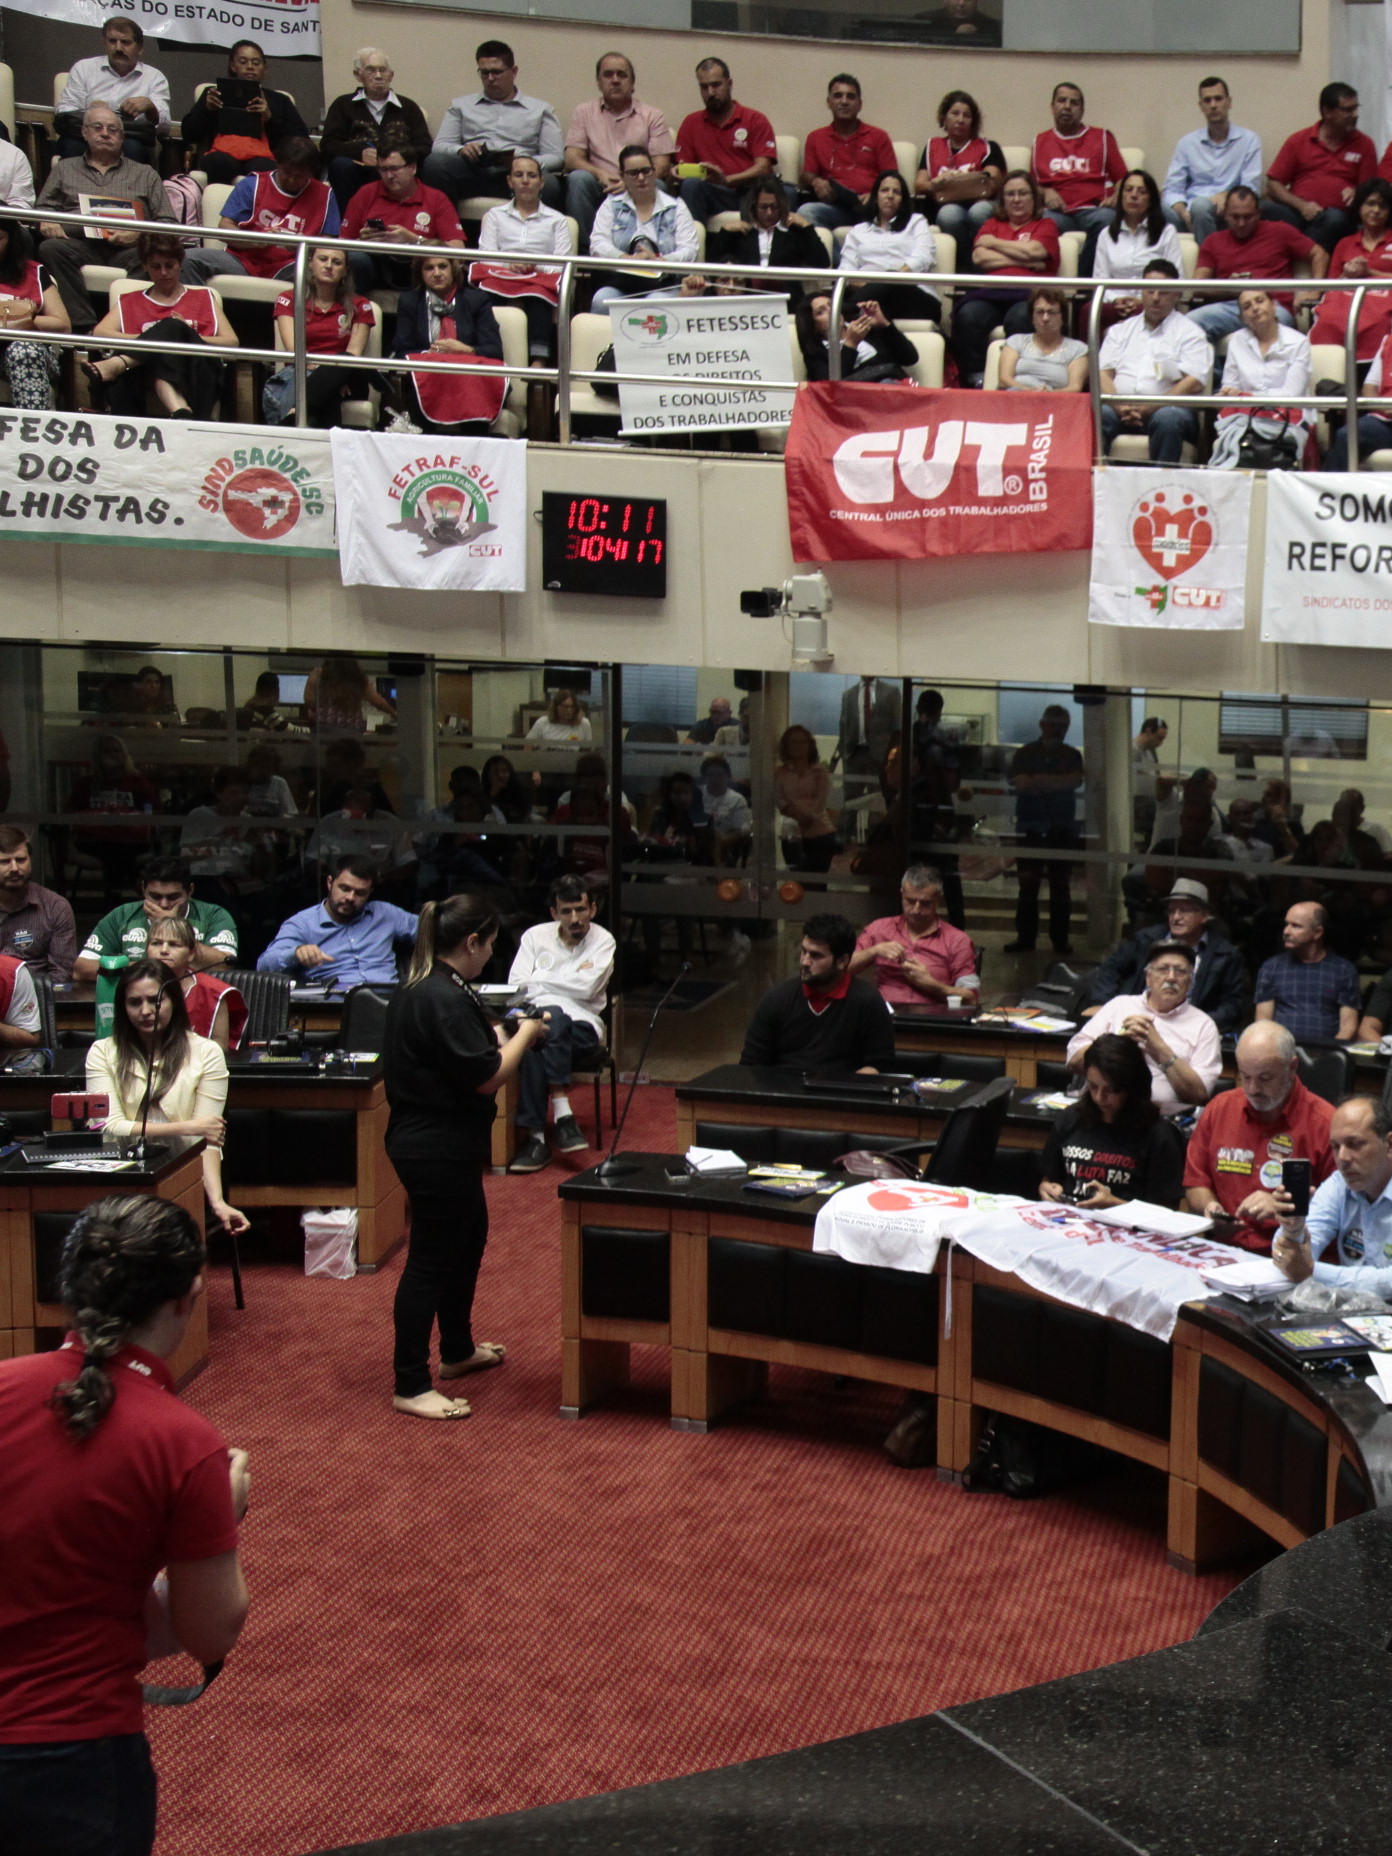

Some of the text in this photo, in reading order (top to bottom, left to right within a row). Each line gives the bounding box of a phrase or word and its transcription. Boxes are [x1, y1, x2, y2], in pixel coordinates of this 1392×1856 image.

[141, 0, 169, 16] DO
[174, 5, 245, 27] ESTADO
[251, 17, 275, 33] DE
[280, 20, 322, 34] SANT
[686, 314, 782, 333] FETESSESC
[667, 350, 750, 366] EM DEFESA
[659, 390, 767, 408] E CONQUISTAS
[633, 416, 665, 429] DOS
[113, 424, 166, 453] DA
[833, 420, 1028, 504] CUT
[1029, 413, 1055, 501] BRASIL
[17, 452, 100, 485] DOS
[387, 454, 499, 502] FETRAF-SUL
[567, 498, 655, 534] 10:11
[829, 502, 1048, 522] CENTRAL ÚNICA DOS TRABALHADORES
[469, 545, 503, 557] CUT
[1173, 587, 1222, 607] CUT
[1302, 596, 1370, 610] SINDICATOS
